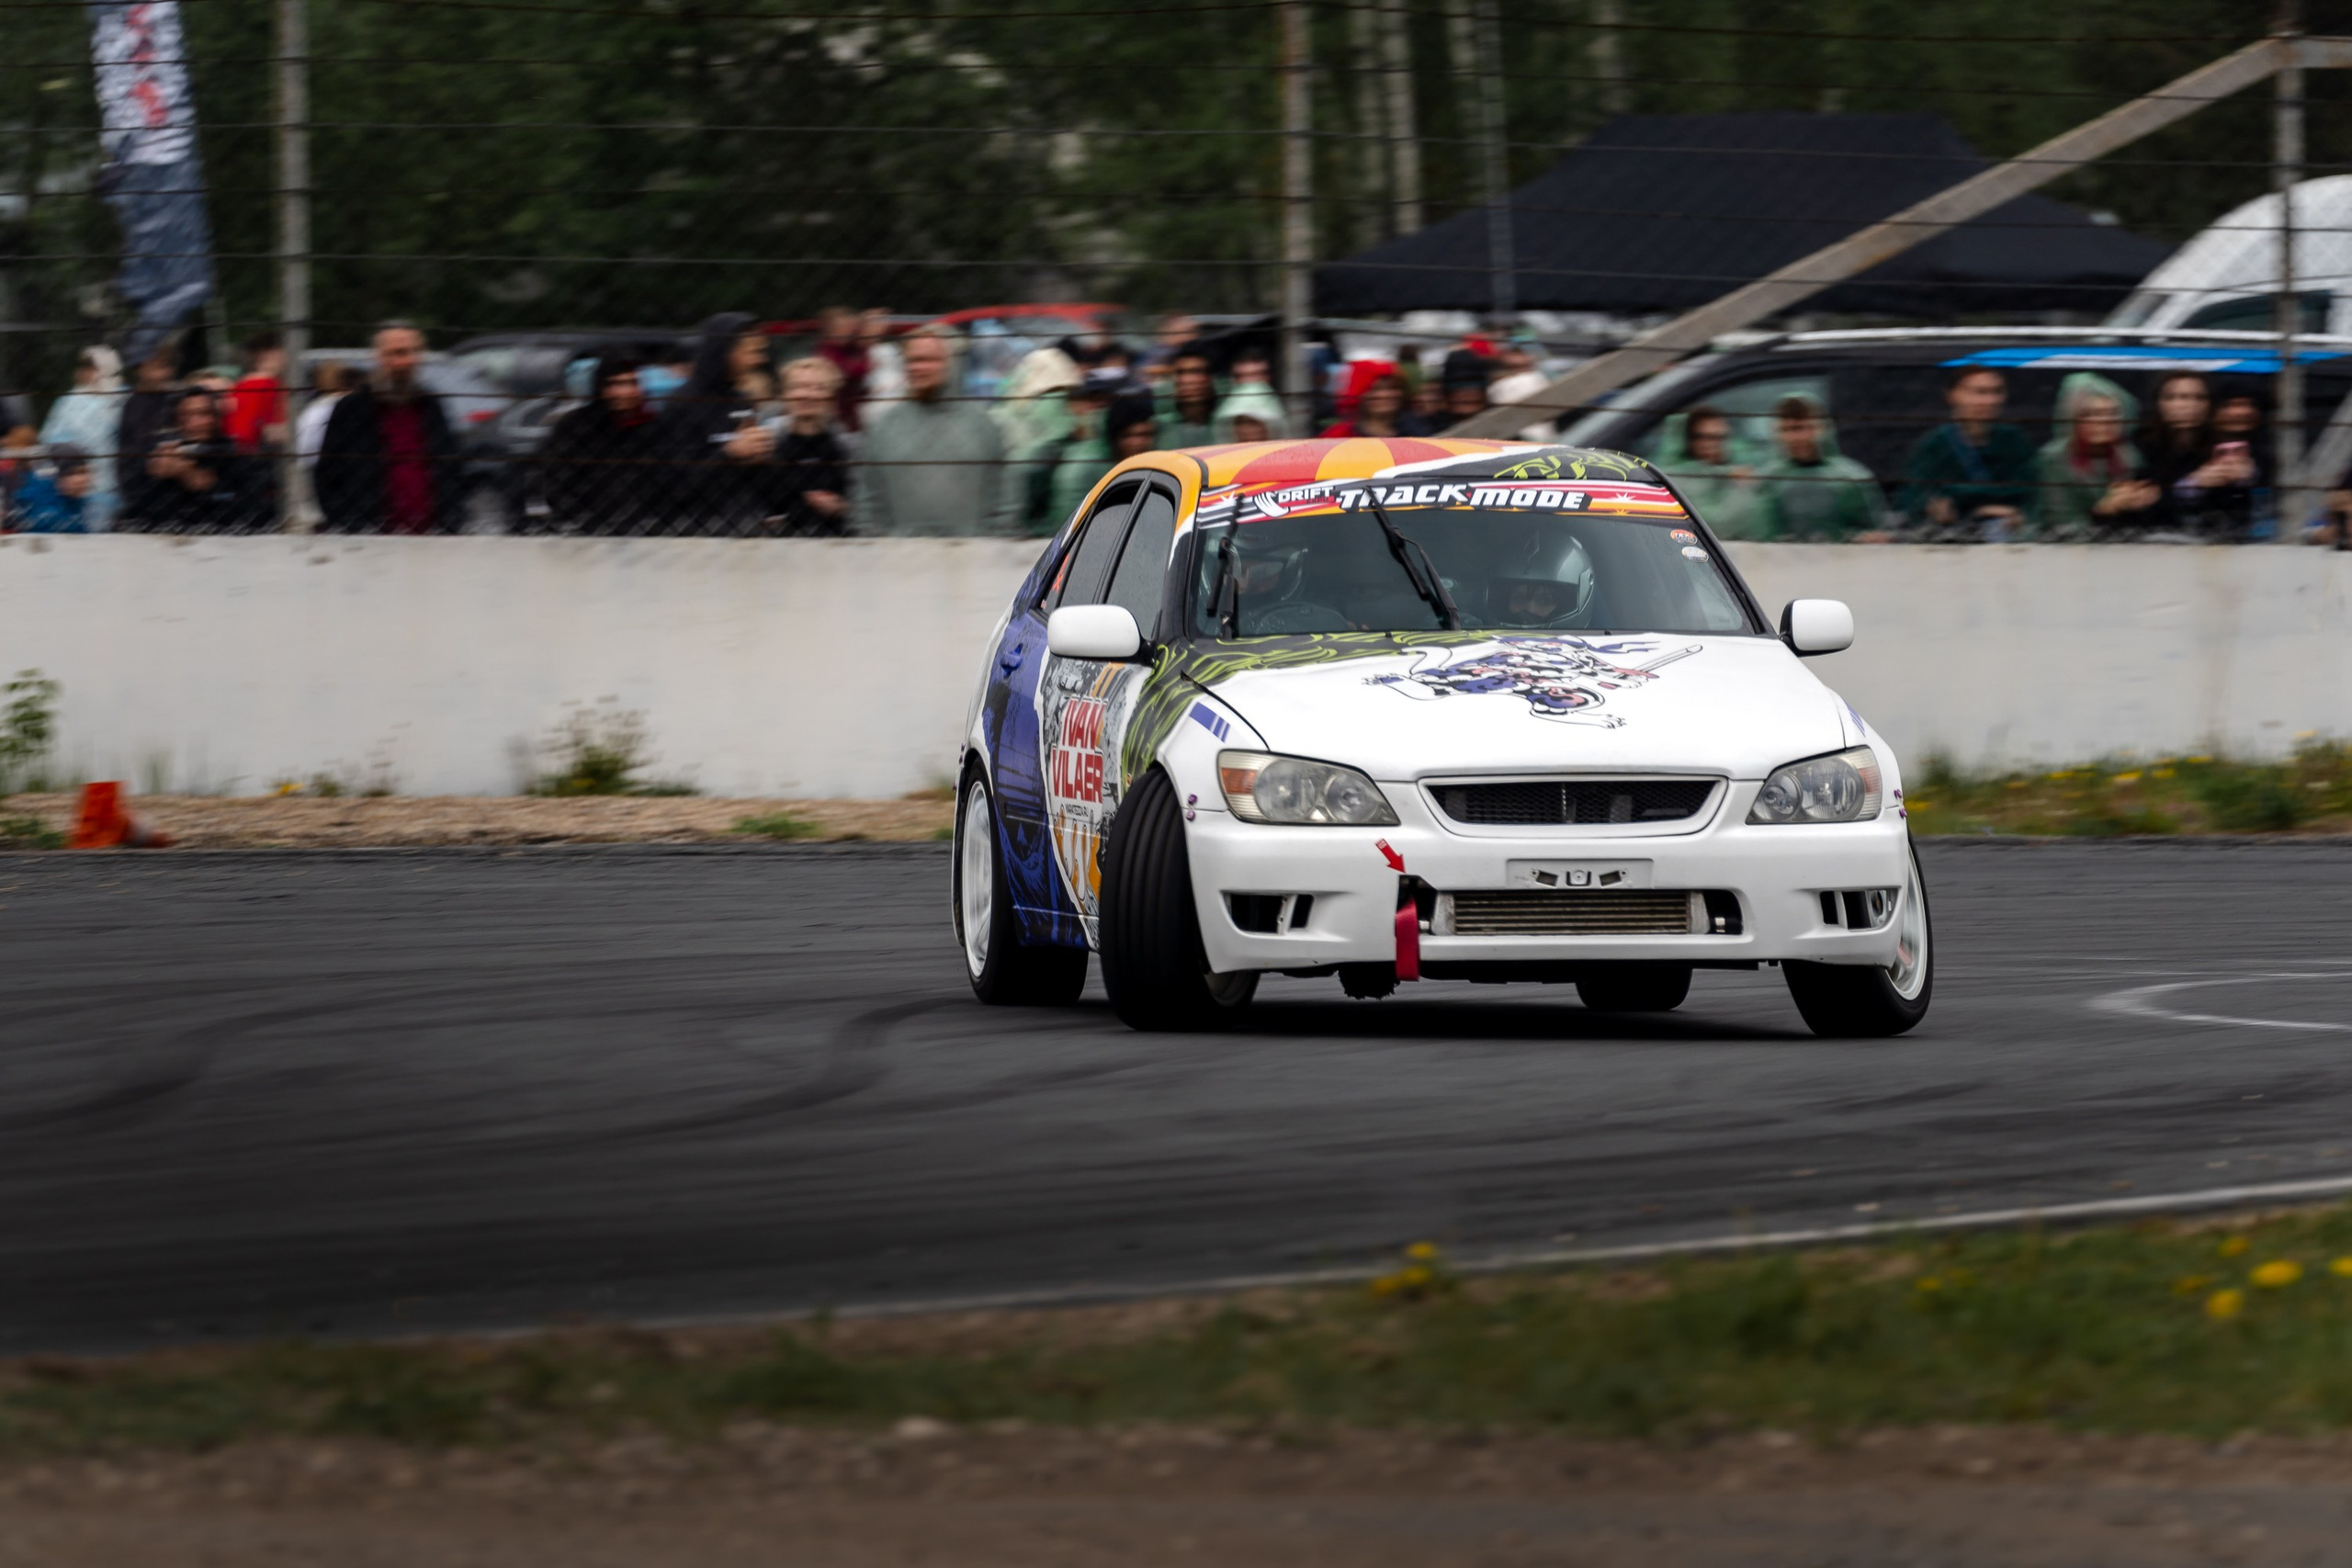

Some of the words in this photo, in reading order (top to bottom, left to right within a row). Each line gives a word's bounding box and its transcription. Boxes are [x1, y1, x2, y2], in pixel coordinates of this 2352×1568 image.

[1278, 486, 1334, 503] DRIFT
[1340, 484, 1469, 508] TRACK
[1470, 489, 1585, 509] MODE
[1062, 699, 1106, 750] IVAN
[1052, 749, 1103, 804] VILAER
